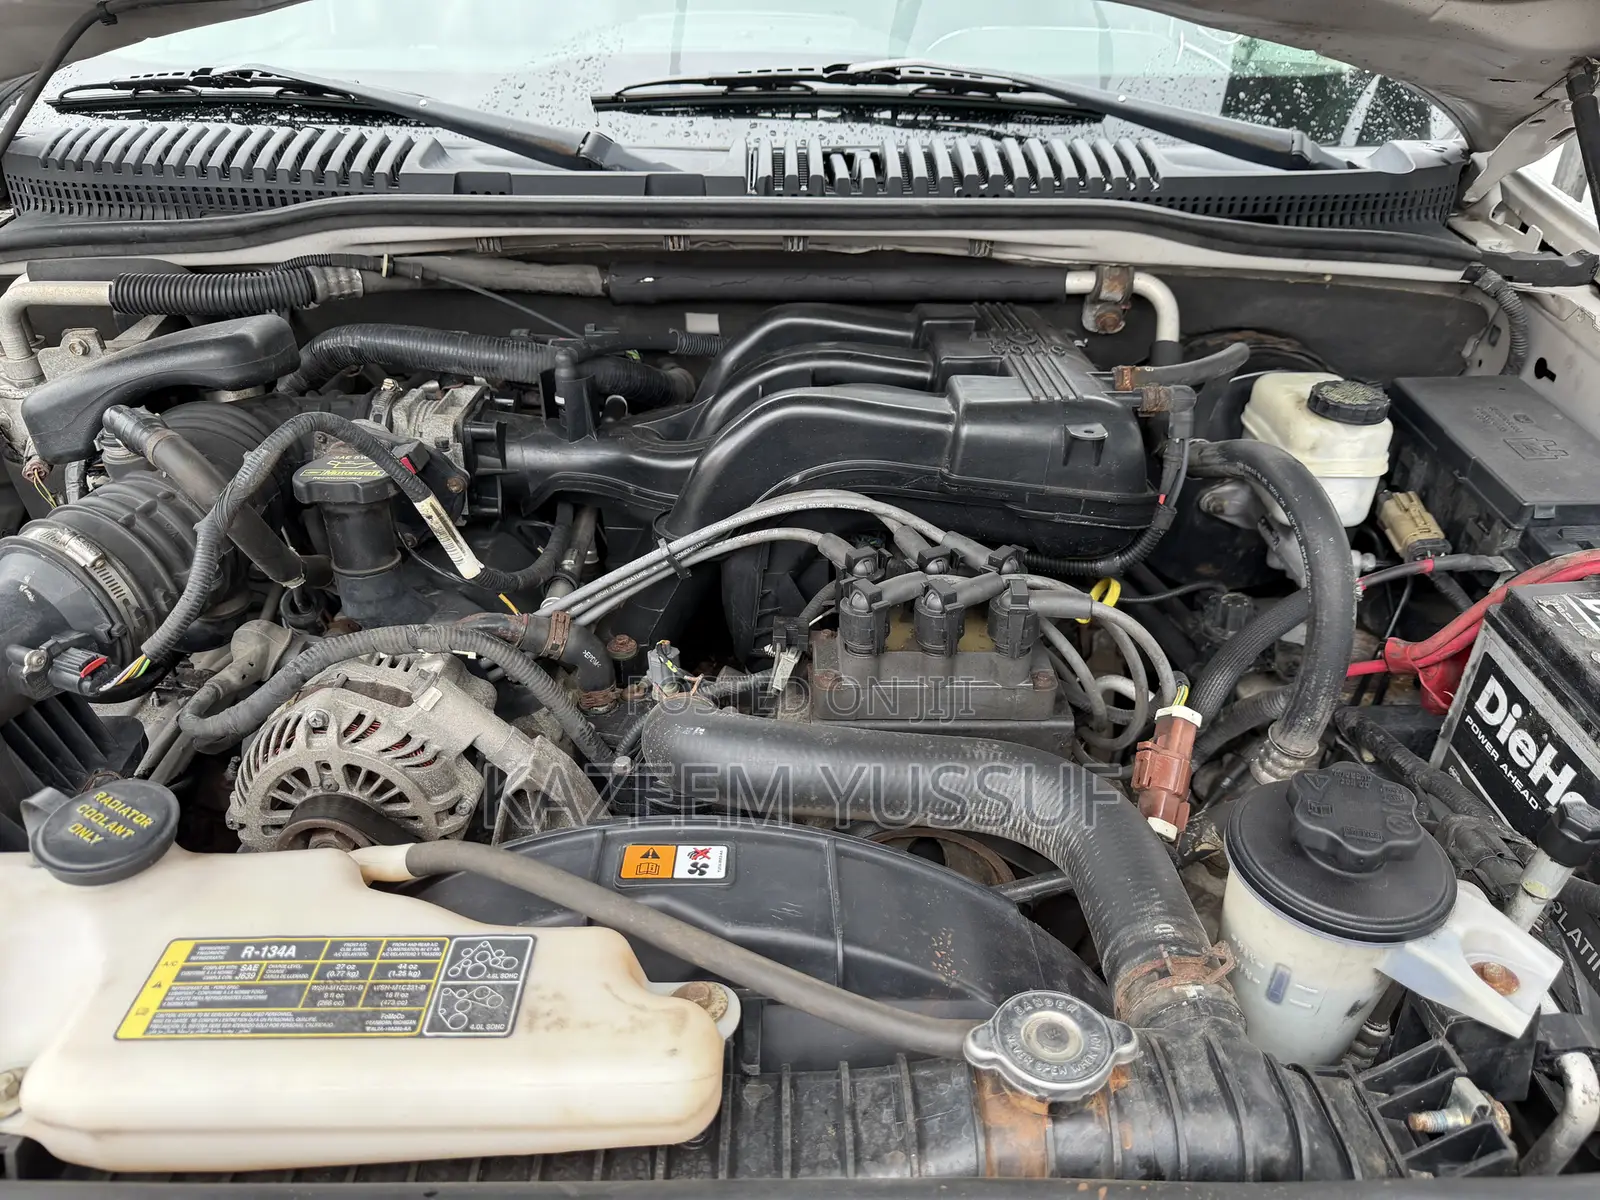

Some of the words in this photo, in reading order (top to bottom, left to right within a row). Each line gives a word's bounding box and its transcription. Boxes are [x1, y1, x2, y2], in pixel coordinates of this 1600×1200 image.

[1464, 715, 1500, 762] POWER
[94, 791, 155, 828] RADIATOR
[76, 803, 135, 839] COOLANT
[68, 822, 104, 846] ONLY
[240, 945, 297, 959] R-134A
[235, 971, 256, 980] J639
[326, 970, 345, 978] (0.77
[346, 970, 360, 978] kg)
[407, 970, 421, 978] kg)
[1013, 997, 1081, 1016] DANGER
